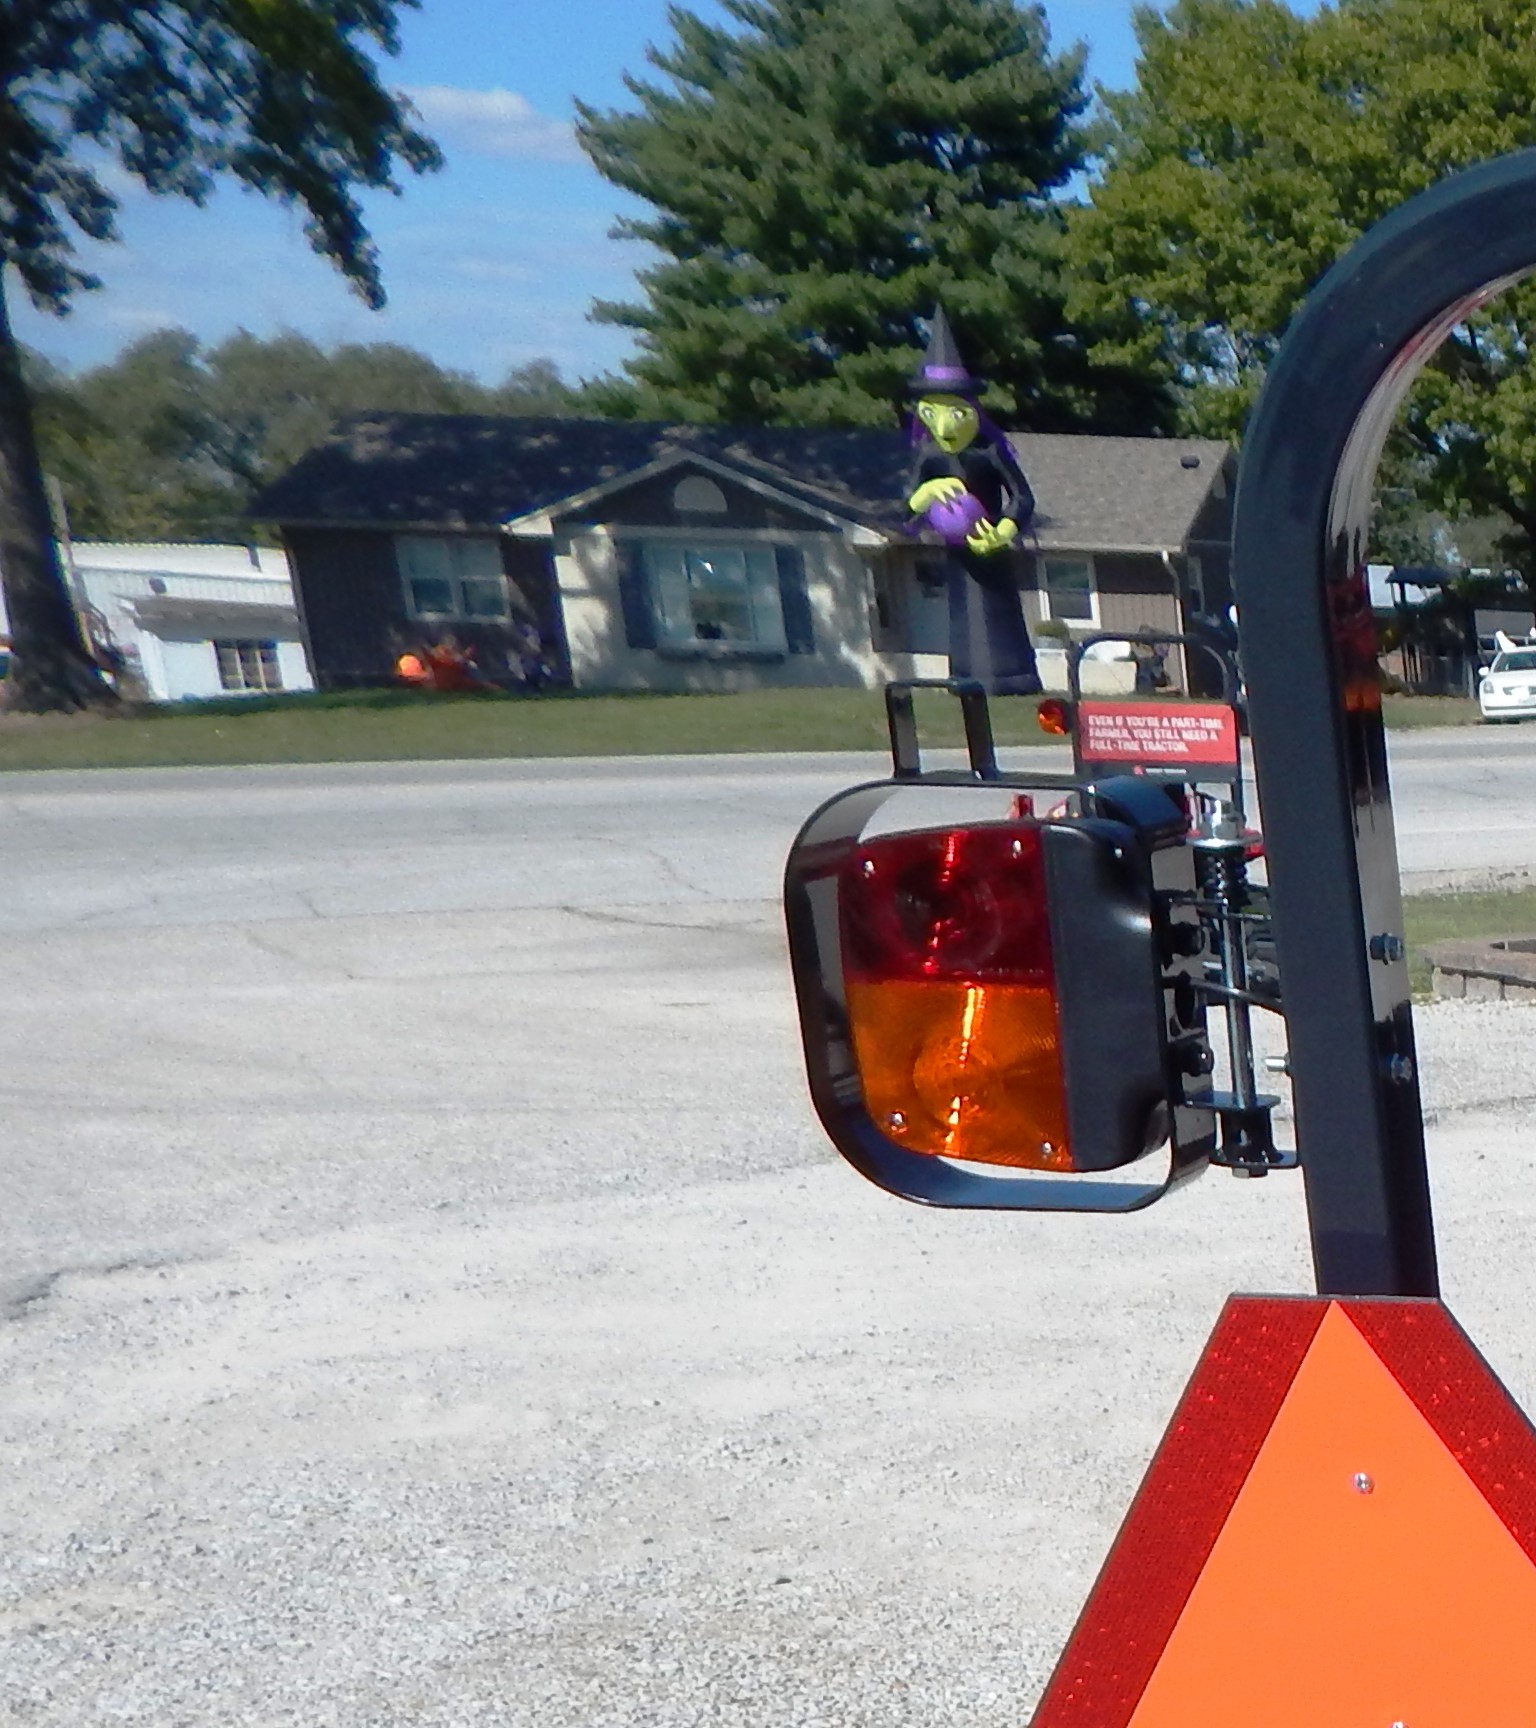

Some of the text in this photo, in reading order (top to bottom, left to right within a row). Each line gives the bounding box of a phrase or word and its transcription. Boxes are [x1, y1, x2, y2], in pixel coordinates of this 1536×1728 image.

[1088, 715, 1114, 726] EVEN
[1162, 716, 1171, 727] A
[1171, 717, 1223, 729] PART-TIME
[1133, 729, 1152, 739] YOU
[1154, 729, 1180, 740] STILL
[1182, 730, 1208, 741] NEED
[1090, 739, 1141, 751] FULL-TIME
